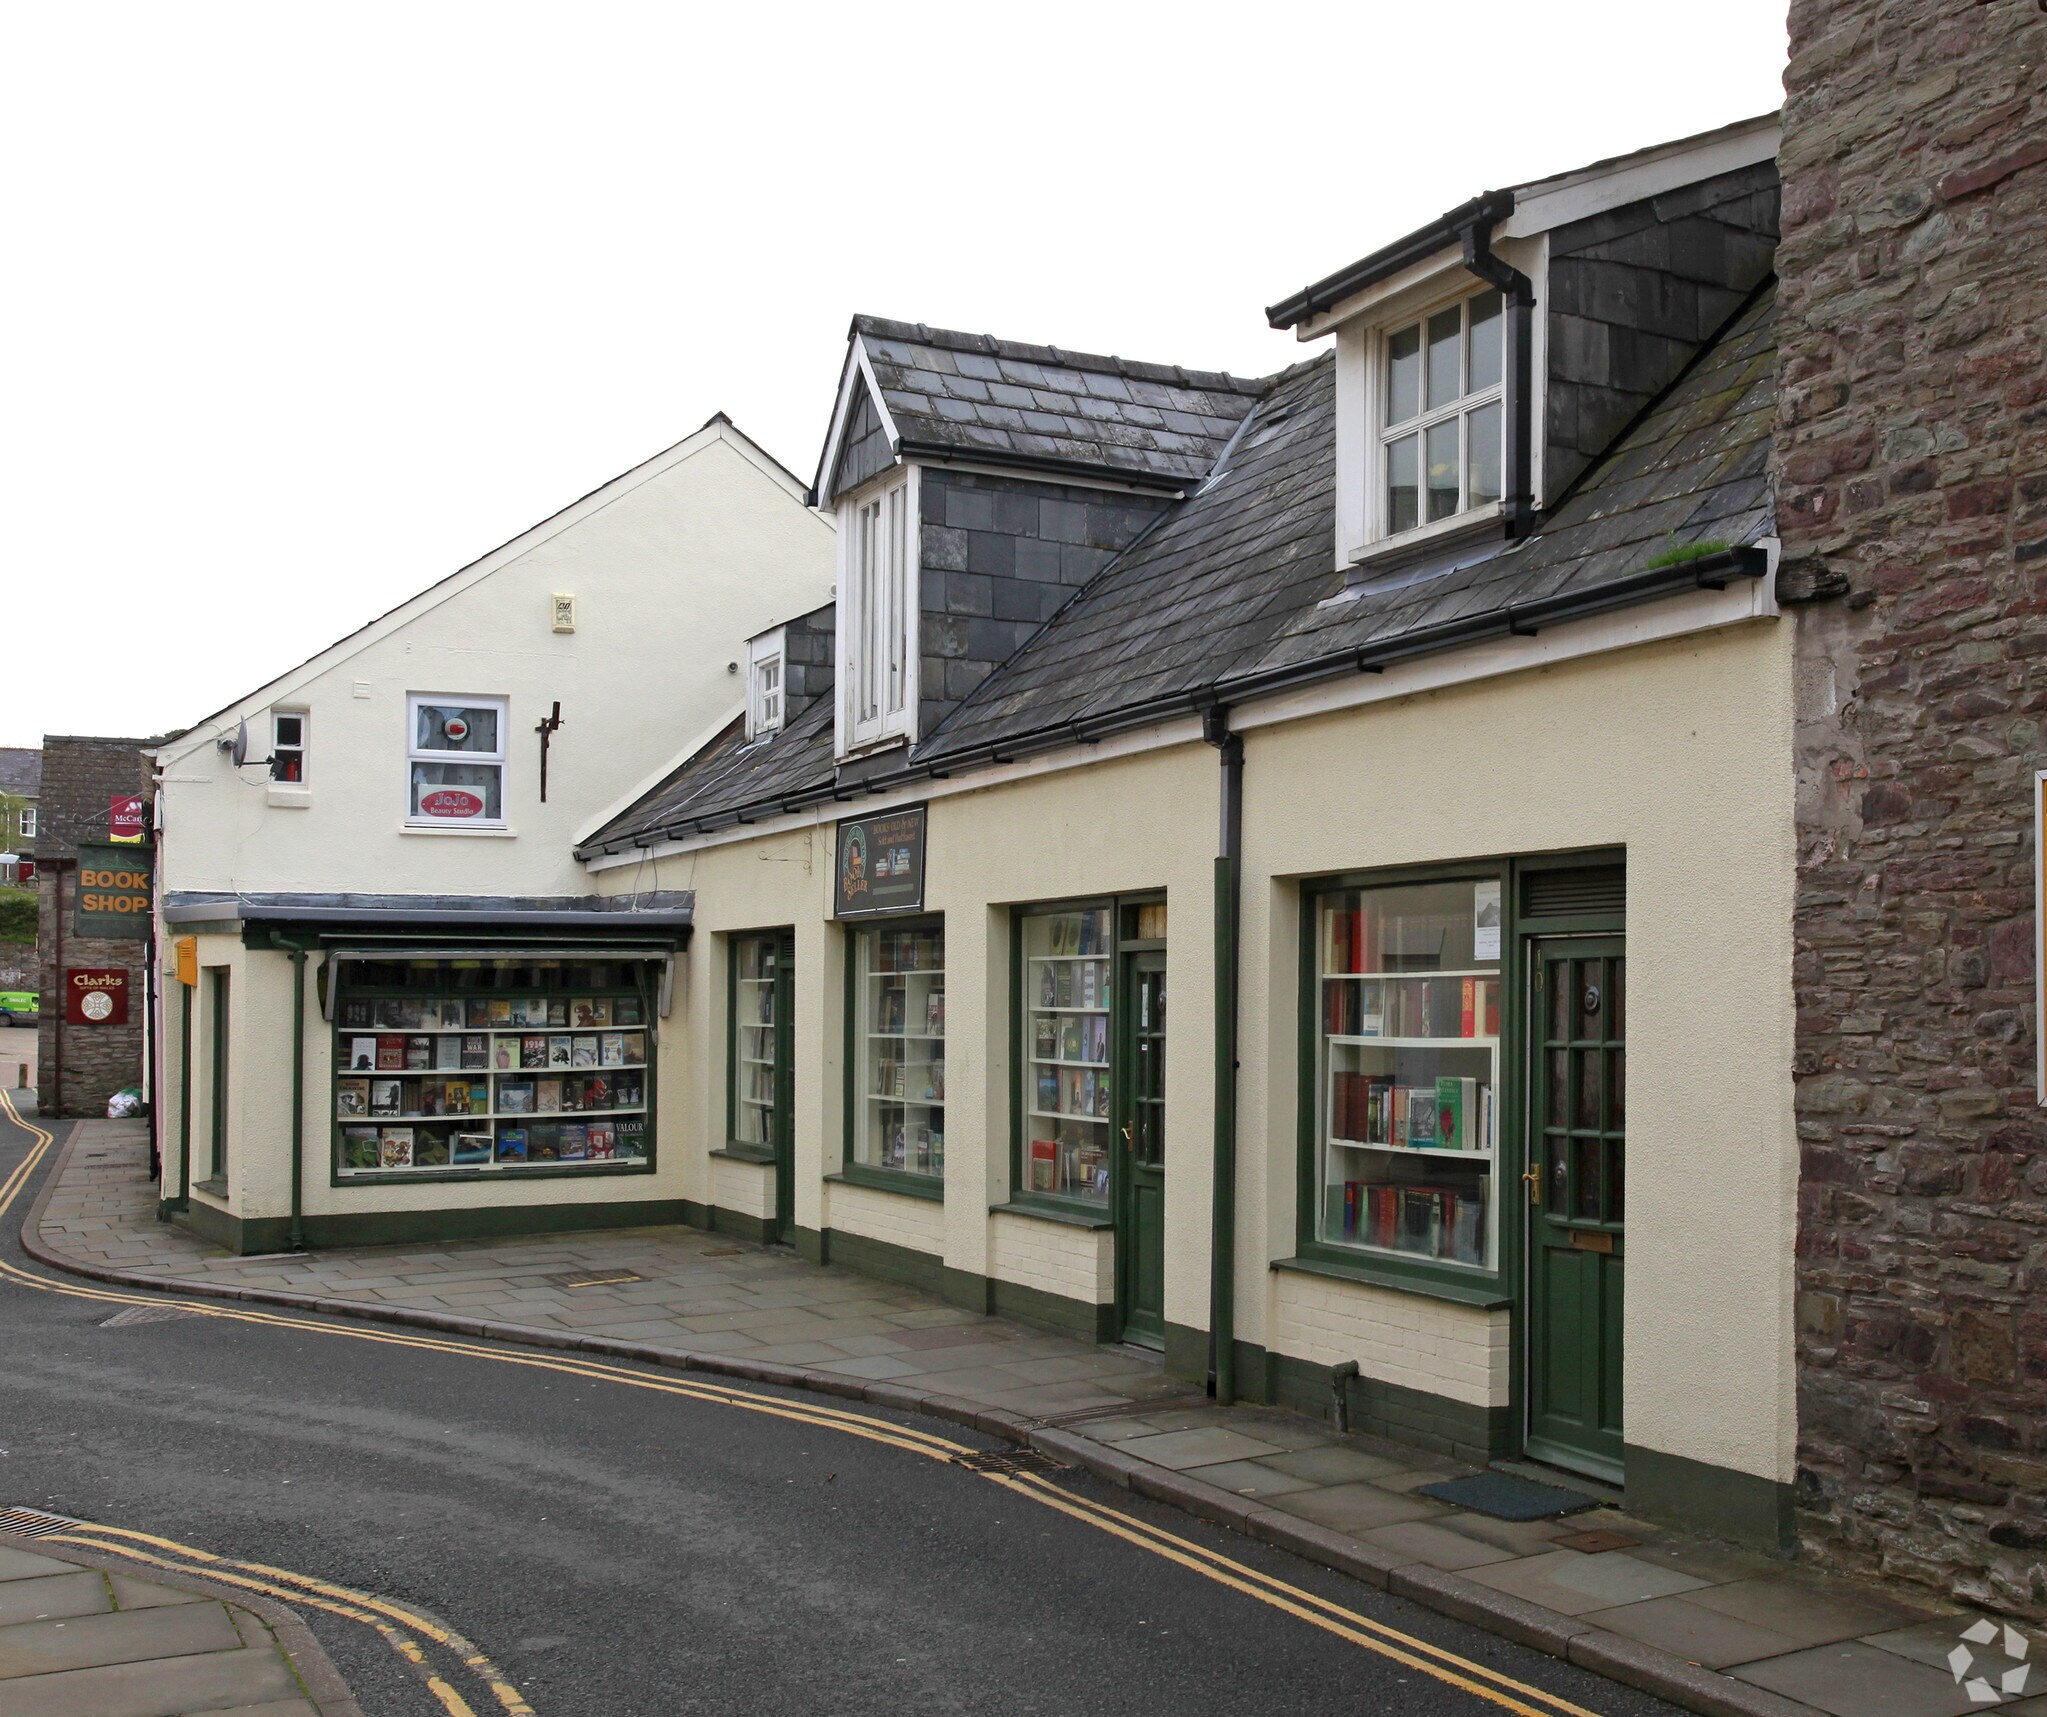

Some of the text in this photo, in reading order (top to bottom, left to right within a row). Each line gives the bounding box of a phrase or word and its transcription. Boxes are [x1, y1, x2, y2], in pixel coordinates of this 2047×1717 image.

[435, 793, 469, 806] JoJo
[430, 807, 474, 815] Beauty Studio
[81, 870, 149, 890] BOOK
[82, 894, 148, 913] SHOP
[73, 974, 123, 986] Clarks
[615, 1122, 644, 1132] VALOUR
